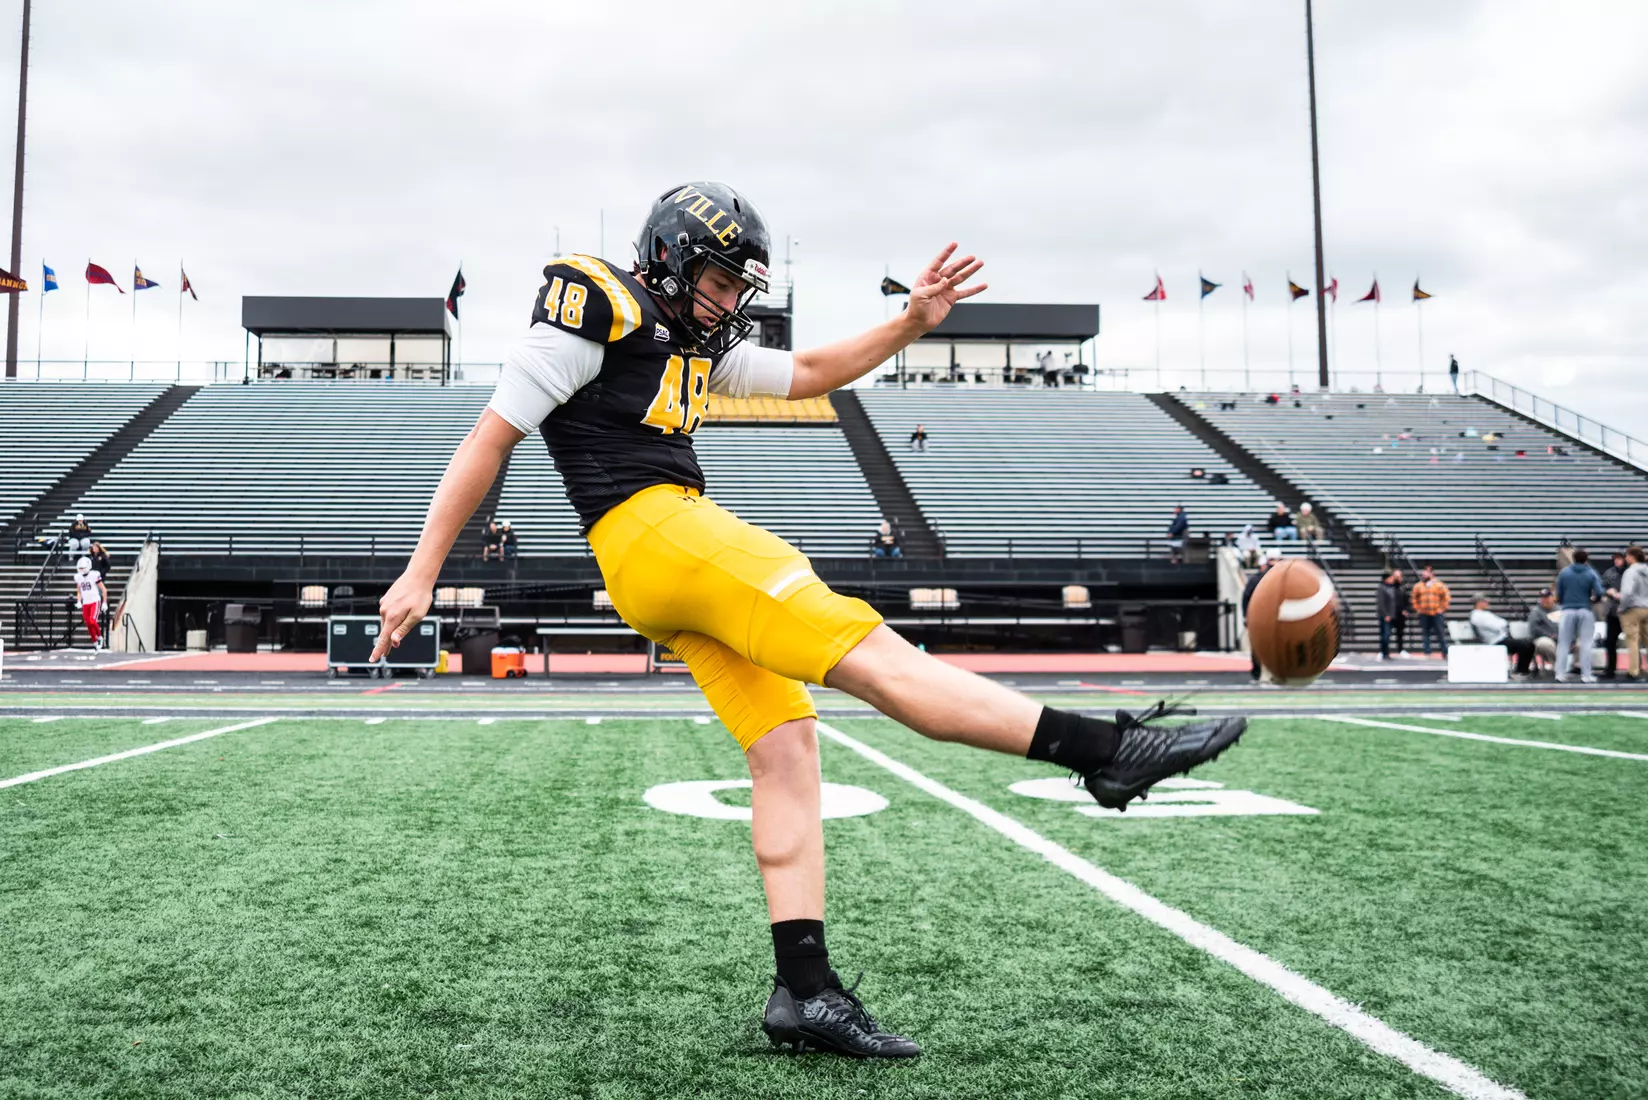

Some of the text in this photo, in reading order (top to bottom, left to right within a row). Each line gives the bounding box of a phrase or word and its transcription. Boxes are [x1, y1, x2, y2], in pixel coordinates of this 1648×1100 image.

[674, 185, 743, 247] VILLE
[544, 276, 588, 329] 48
[640, 354, 712, 435] 48
